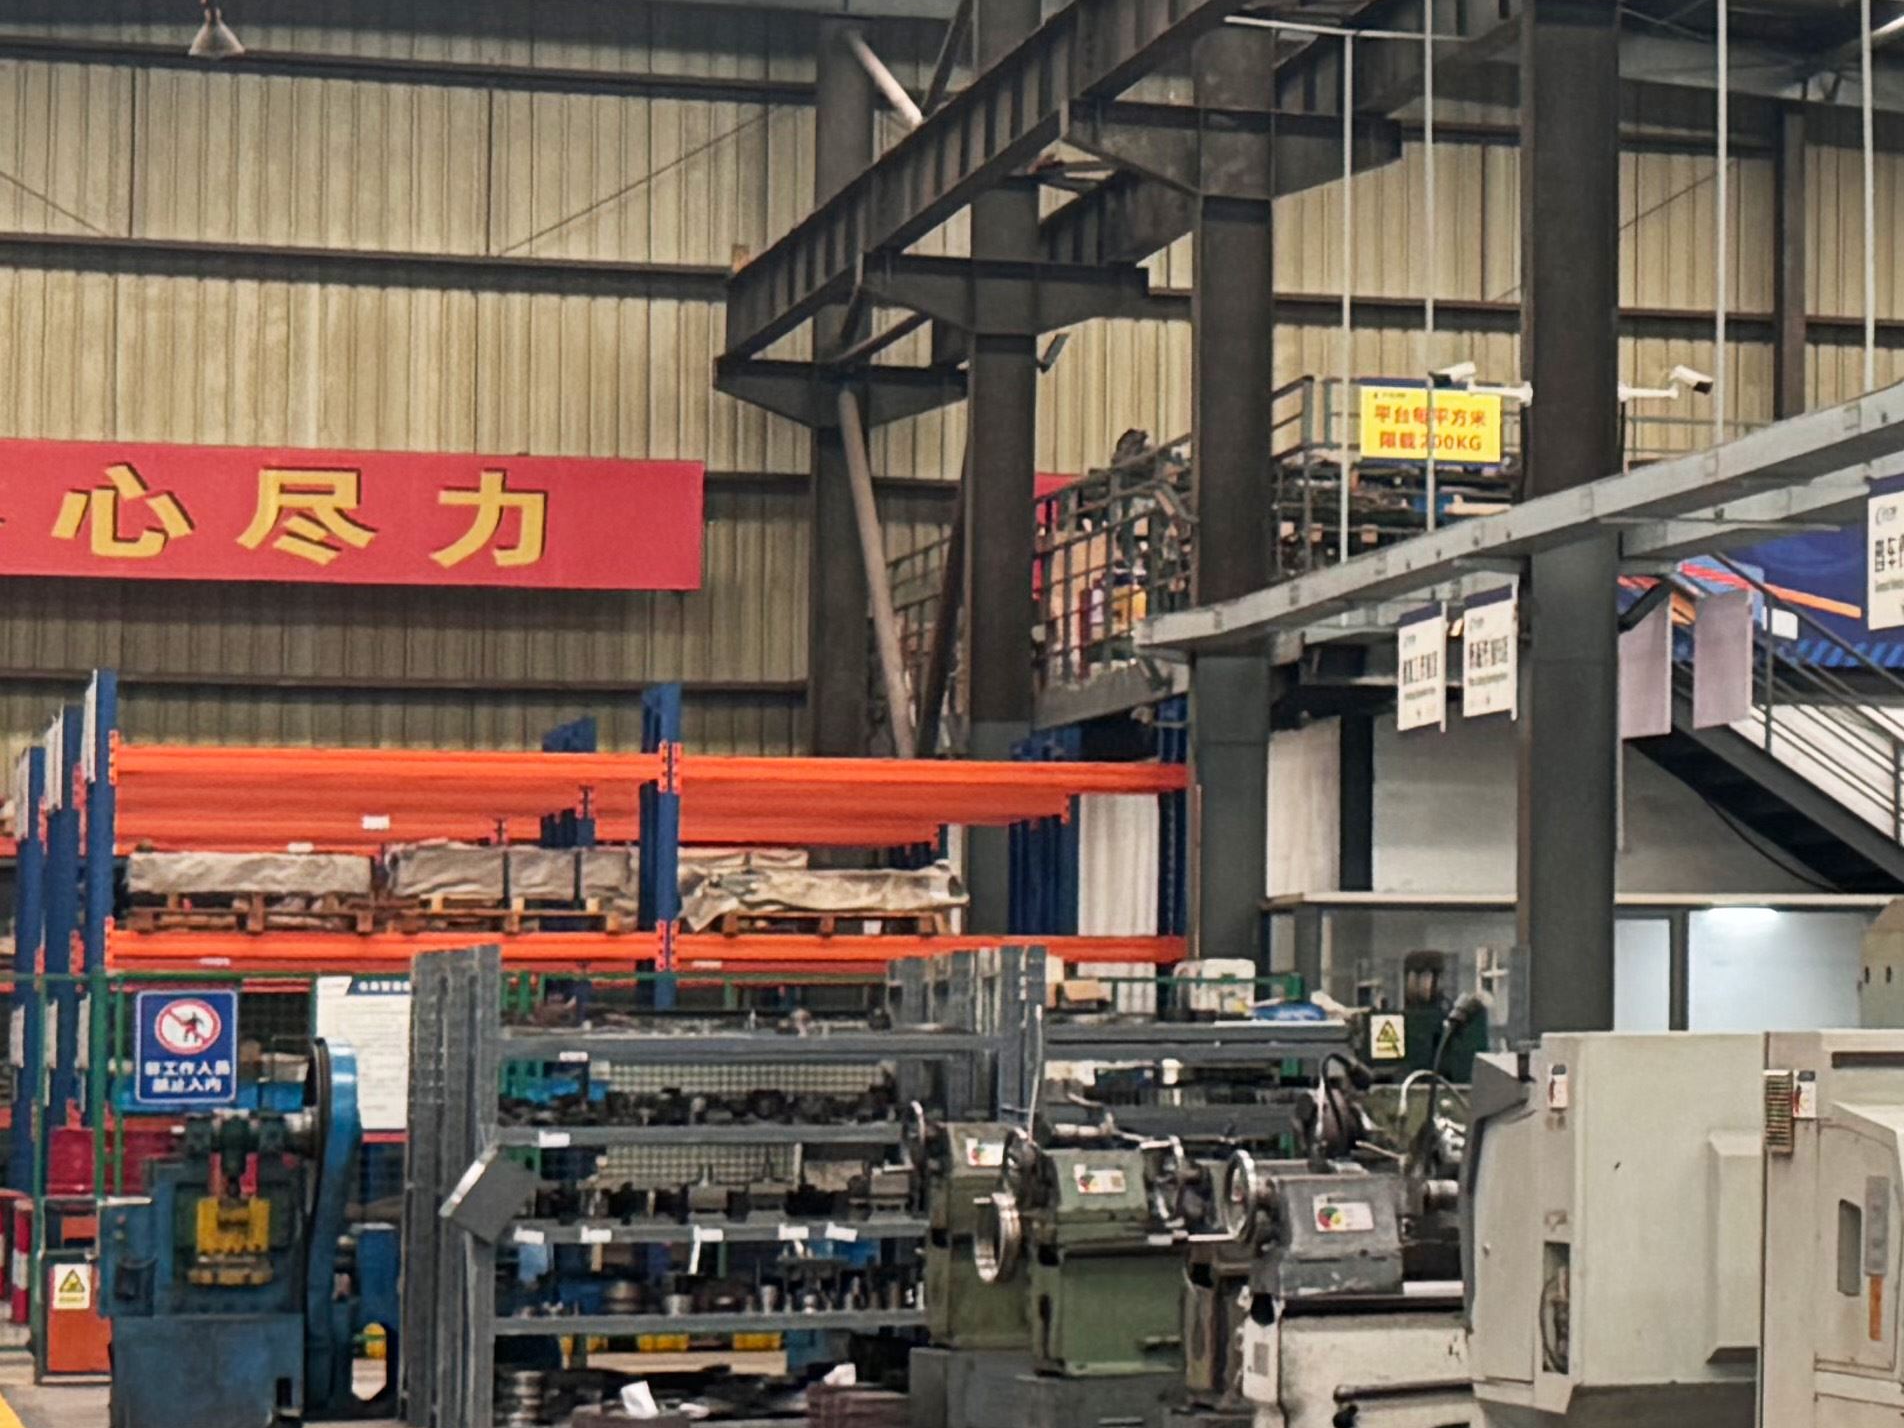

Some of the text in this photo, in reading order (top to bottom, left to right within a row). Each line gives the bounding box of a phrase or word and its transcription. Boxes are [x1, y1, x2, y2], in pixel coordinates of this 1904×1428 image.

[1374, 404, 1487, 427] 平台每平方米
[51, 461, 549, 568] 心尽力
